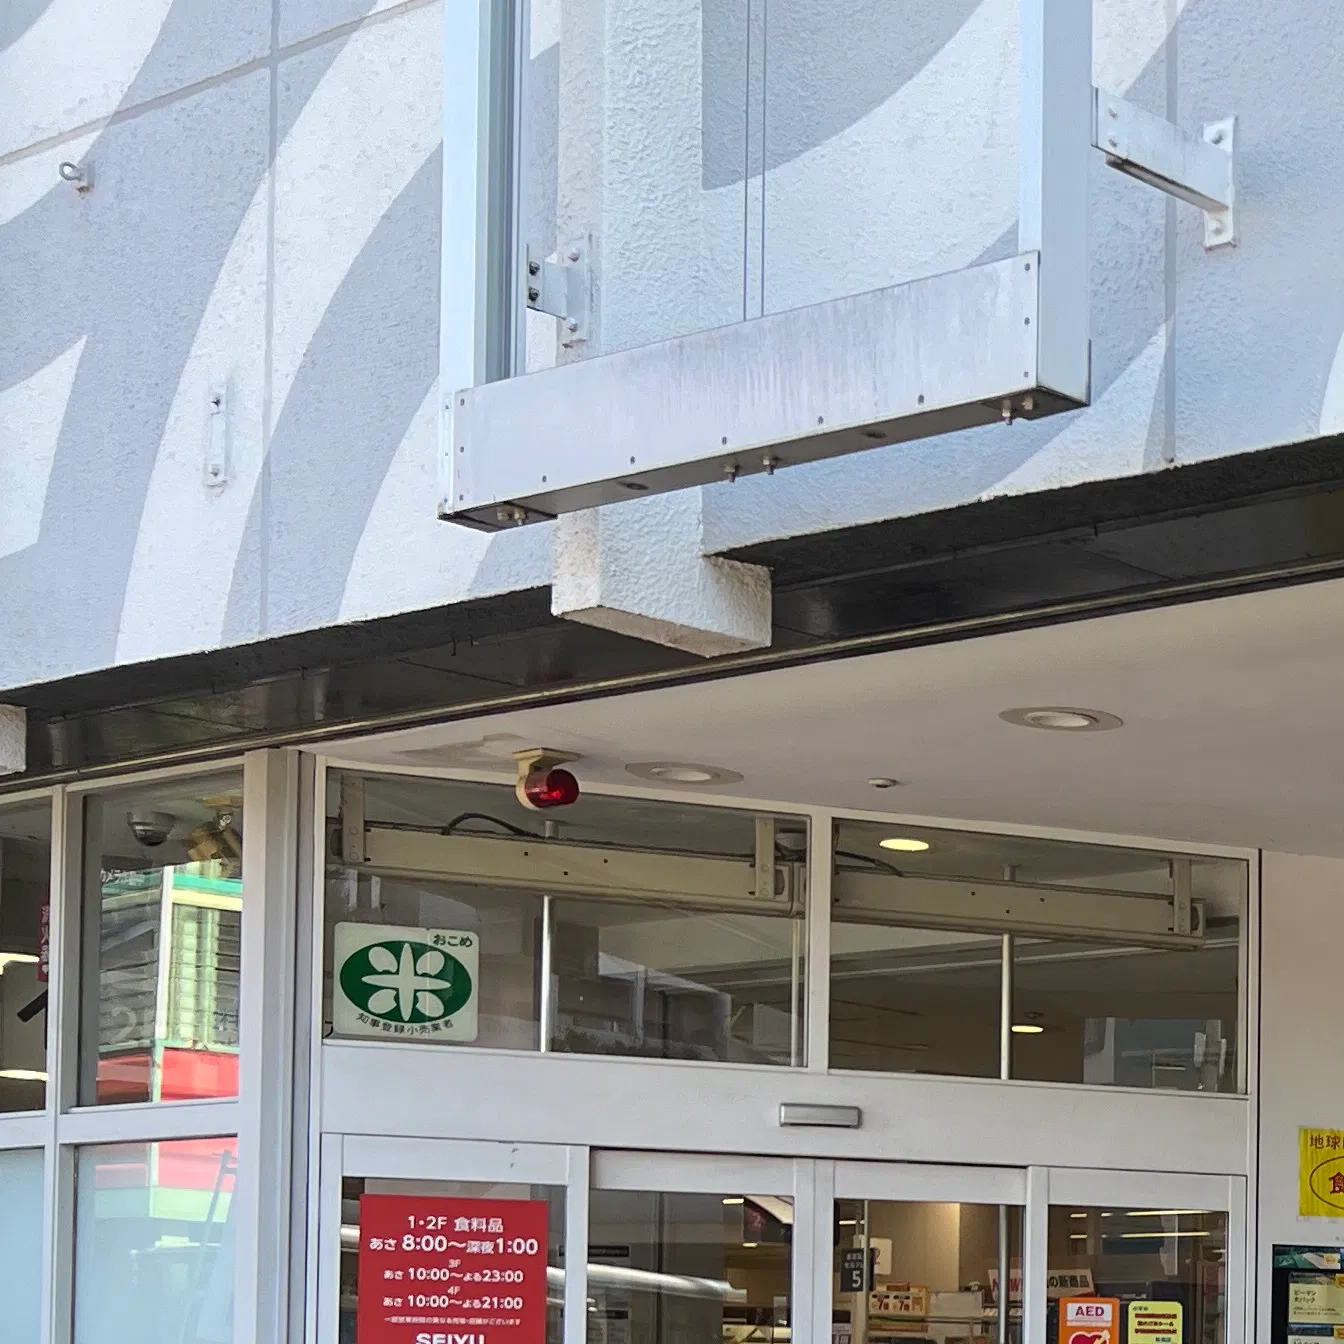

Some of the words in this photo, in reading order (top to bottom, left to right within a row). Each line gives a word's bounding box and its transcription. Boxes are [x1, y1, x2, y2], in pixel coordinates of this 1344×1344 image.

[433, 933, 473, 948] おこめ
[453, 1217, 504, 1234] 食料品
[369, 1237, 398, 1252] あさ
[1075, 1305, 1106, 1318] AED
